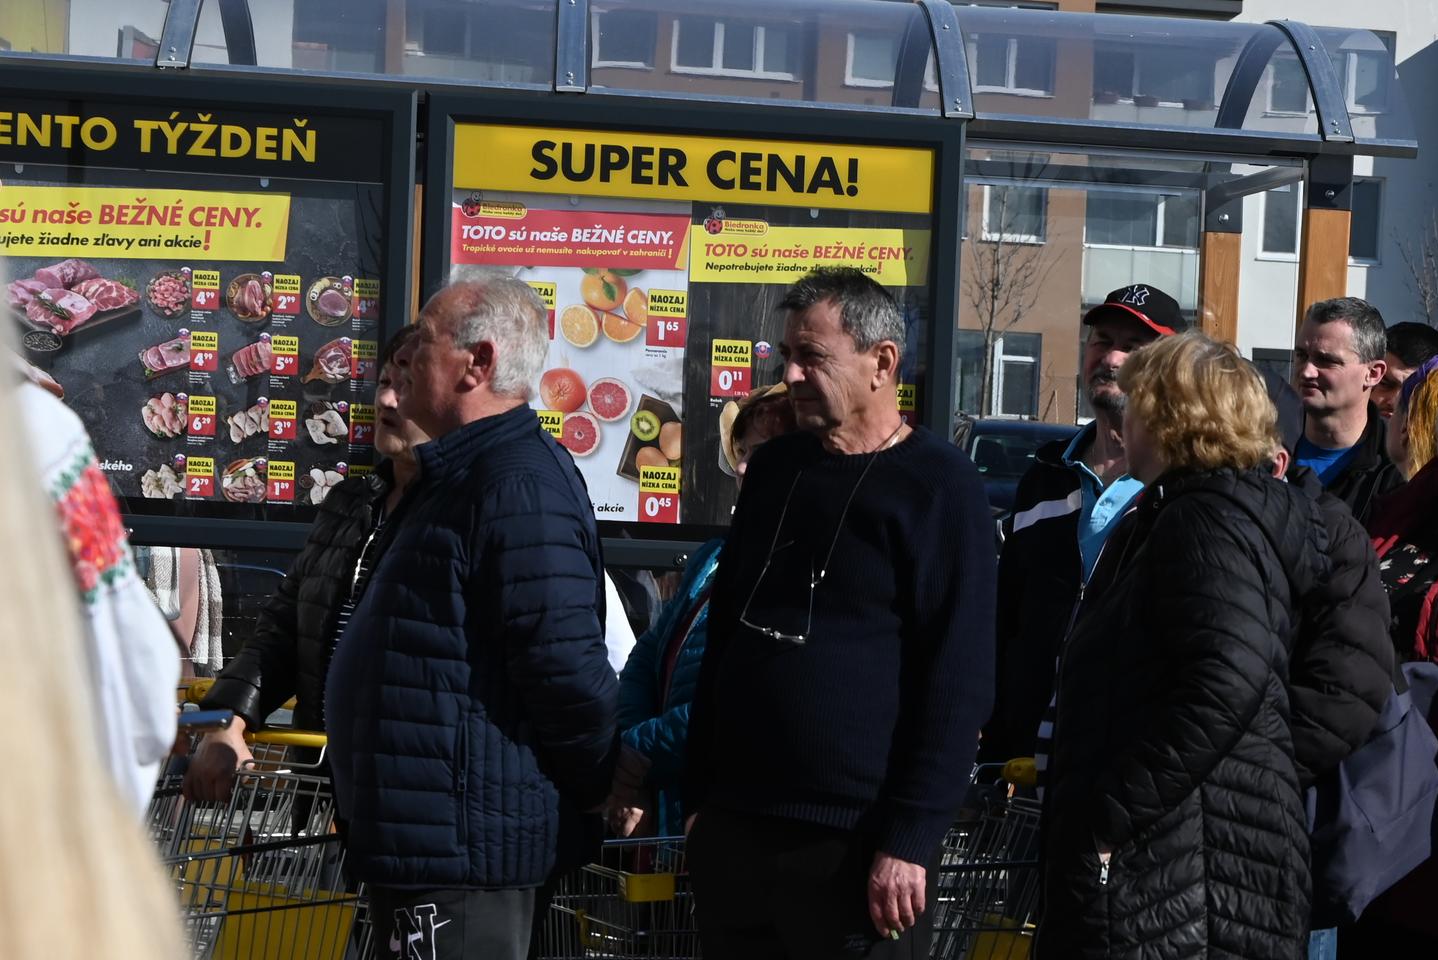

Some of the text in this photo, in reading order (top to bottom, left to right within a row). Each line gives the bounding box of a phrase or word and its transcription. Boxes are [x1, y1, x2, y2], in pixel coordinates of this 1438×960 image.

[134, 112, 316, 163] TÝŽDEŇ
[530, 140, 859, 197] SUPER CENA!
[0, 197, 262, 228] sú naše BEŽNÉ CENY.
[462, 224, 674, 245] TOTO sú naše BEŽNÉ CENY.
[38, 232, 89, 246] žiadne
[93, 233, 135, 250] zľavy
[138, 234, 162, 248] ani
[462, 243, 496, 253] Tropické
[497, 245, 523, 253] ovocie
[525, 245, 535, 253] už
[536, 246, 573, 254] nemusíte
[705, 241, 914, 260] TOTO sú naše BEŽNÉ CENY.
[705, 262, 773, 272] Nepotrebujete
[776, 262, 807, 272] žiadne
[194, 273, 218, 281] NAOZAJ
[276, 277, 299, 285] NAOZAJ
[650, 295, 685, 305] NAOZAJ
[273, 339, 297, 347] NAOZAJ
[715, 344, 749, 354] NAOZAJ
[642, 470, 677, 481] NAOZAJ
[597, 503, 624, 513] akcie
